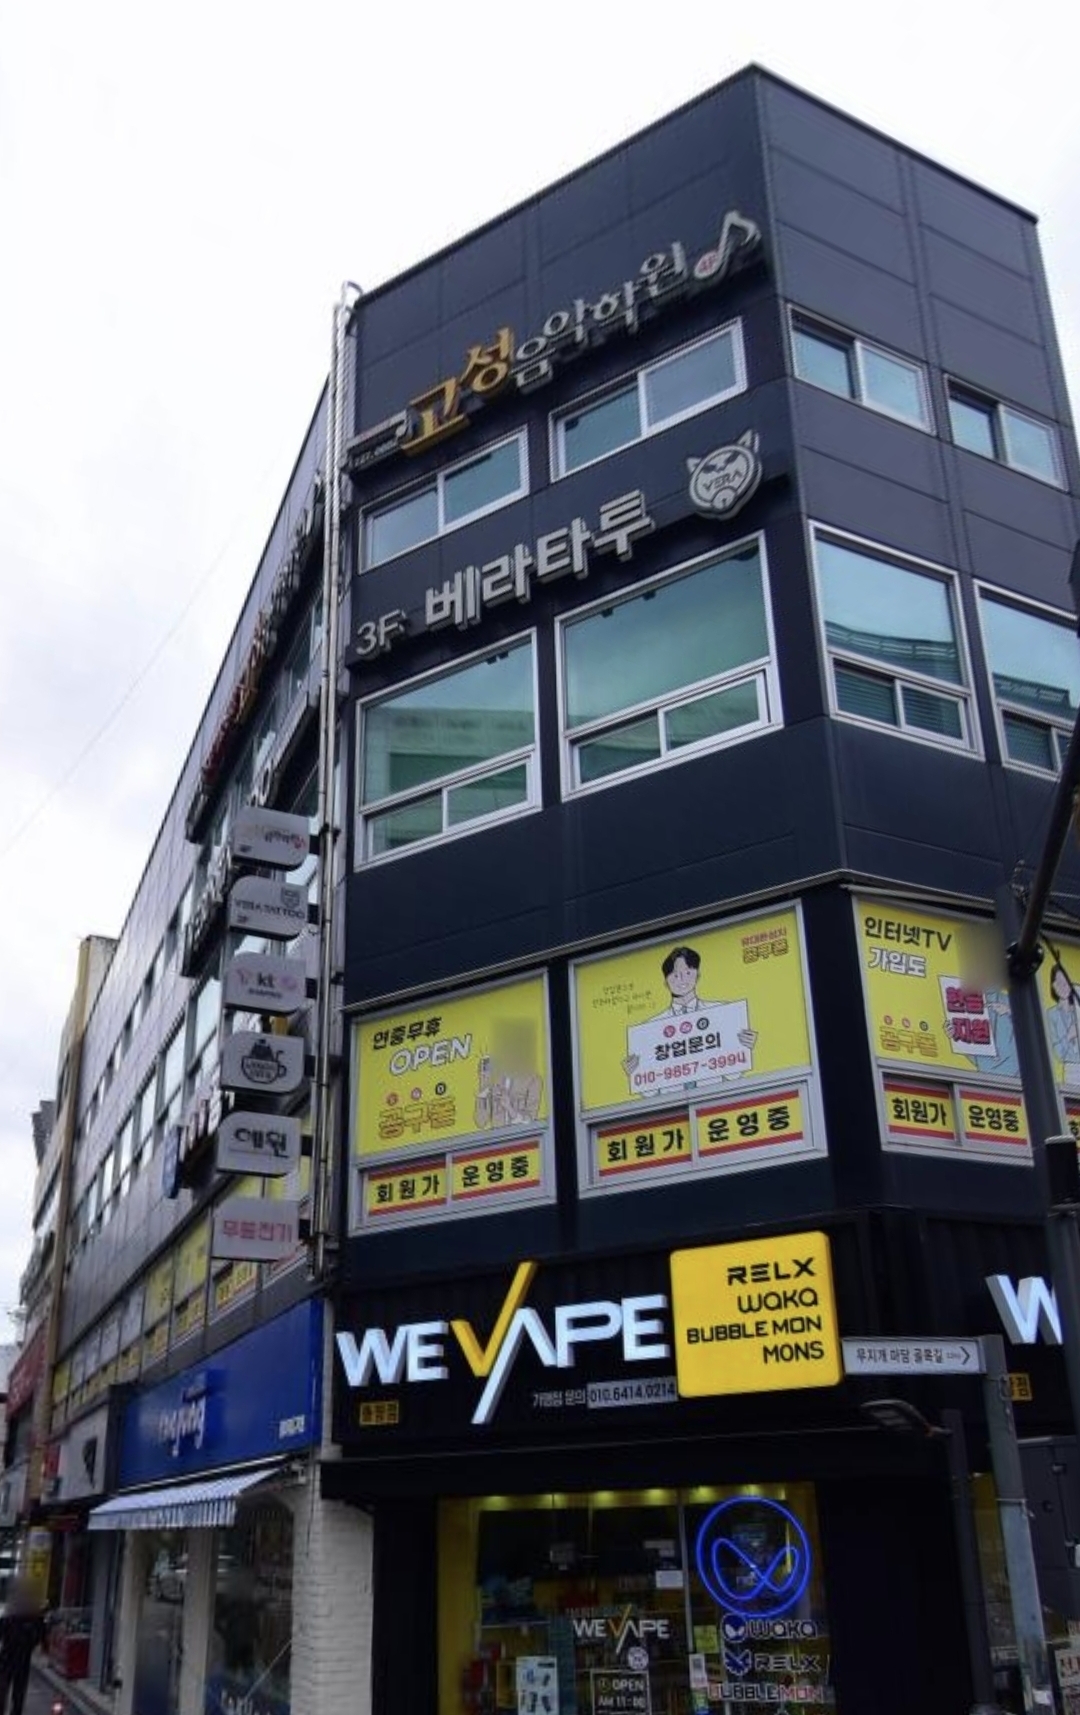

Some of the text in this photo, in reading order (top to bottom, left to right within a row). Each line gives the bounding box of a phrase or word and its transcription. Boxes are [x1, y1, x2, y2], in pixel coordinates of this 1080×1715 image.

[402, 241, 689, 457] 고성음악학원
[702, 469, 743, 492] VERA
[357, 488, 656, 656] 3F 베라타투
[864, 915, 952, 951] 인터넷TV
[867, 946, 928, 978] 가입도
[257, 971, 275, 988] kt
[373, 1016, 443, 1050] 연중무휴
[950, 1016, 991, 1045] 지원
[388, 1033, 473, 1076] OPEN
[654, 1031, 722, 1062] 창업문의
[633, 1051, 747, 1087] 010-9857-3994
[891, 1096, 1020, 1133] 회원가 운영중
[606, 1105, 791, 1162] 회원가 운영중
[376, 1156, 530, 1204] 회원가 운영중
[726, 1256, 816, 1287] RELX
[686, 1319, 769, 1344] BUBBLE
[762, 1339, 825, 1365] MONS
[889, 1347, 910, 1364] 마당
[754, 1652, 823, 1674] RELX
[611, 1677, 645, 1692] OPEN
